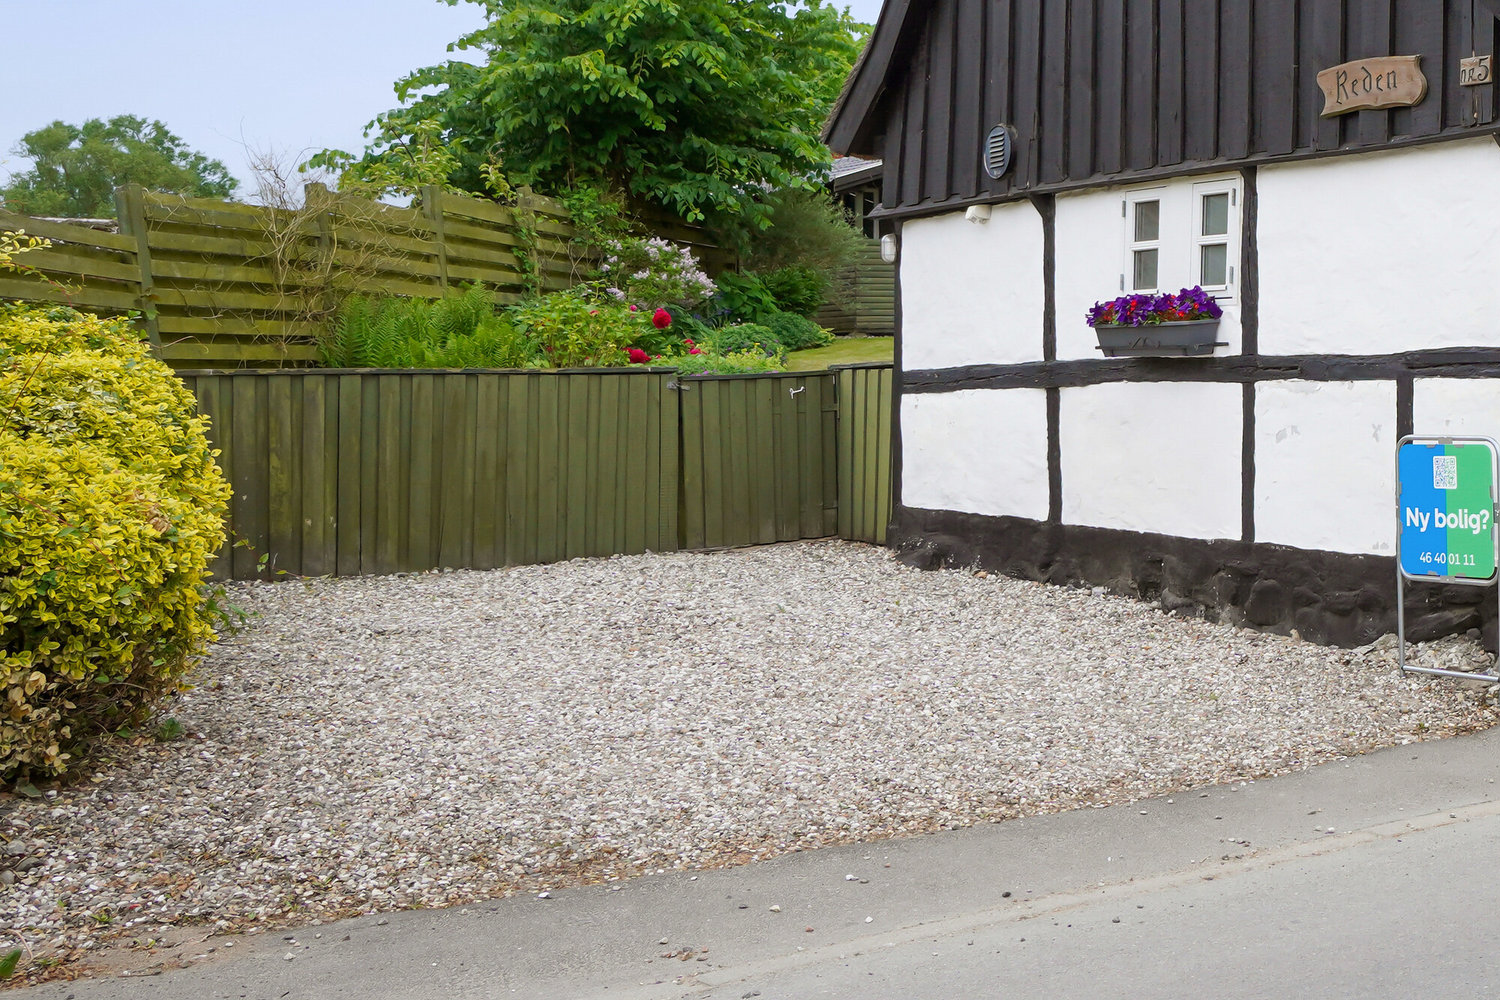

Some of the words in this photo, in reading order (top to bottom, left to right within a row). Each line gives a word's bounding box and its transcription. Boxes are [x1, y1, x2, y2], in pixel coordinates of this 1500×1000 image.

[1477, 57, 1489, 81] 5
[1335, 66, 1398, 104] Reden
[1406, 507, 1430, 532] Ny
[1434, 508, 1490, 534] bolig?
[1419, 552, 1432, 563] 46
[1434, 553, 1446, 564] 40
[1448, 553, 1461, 565] 01
[1463, 554, 1476, 566] 11
